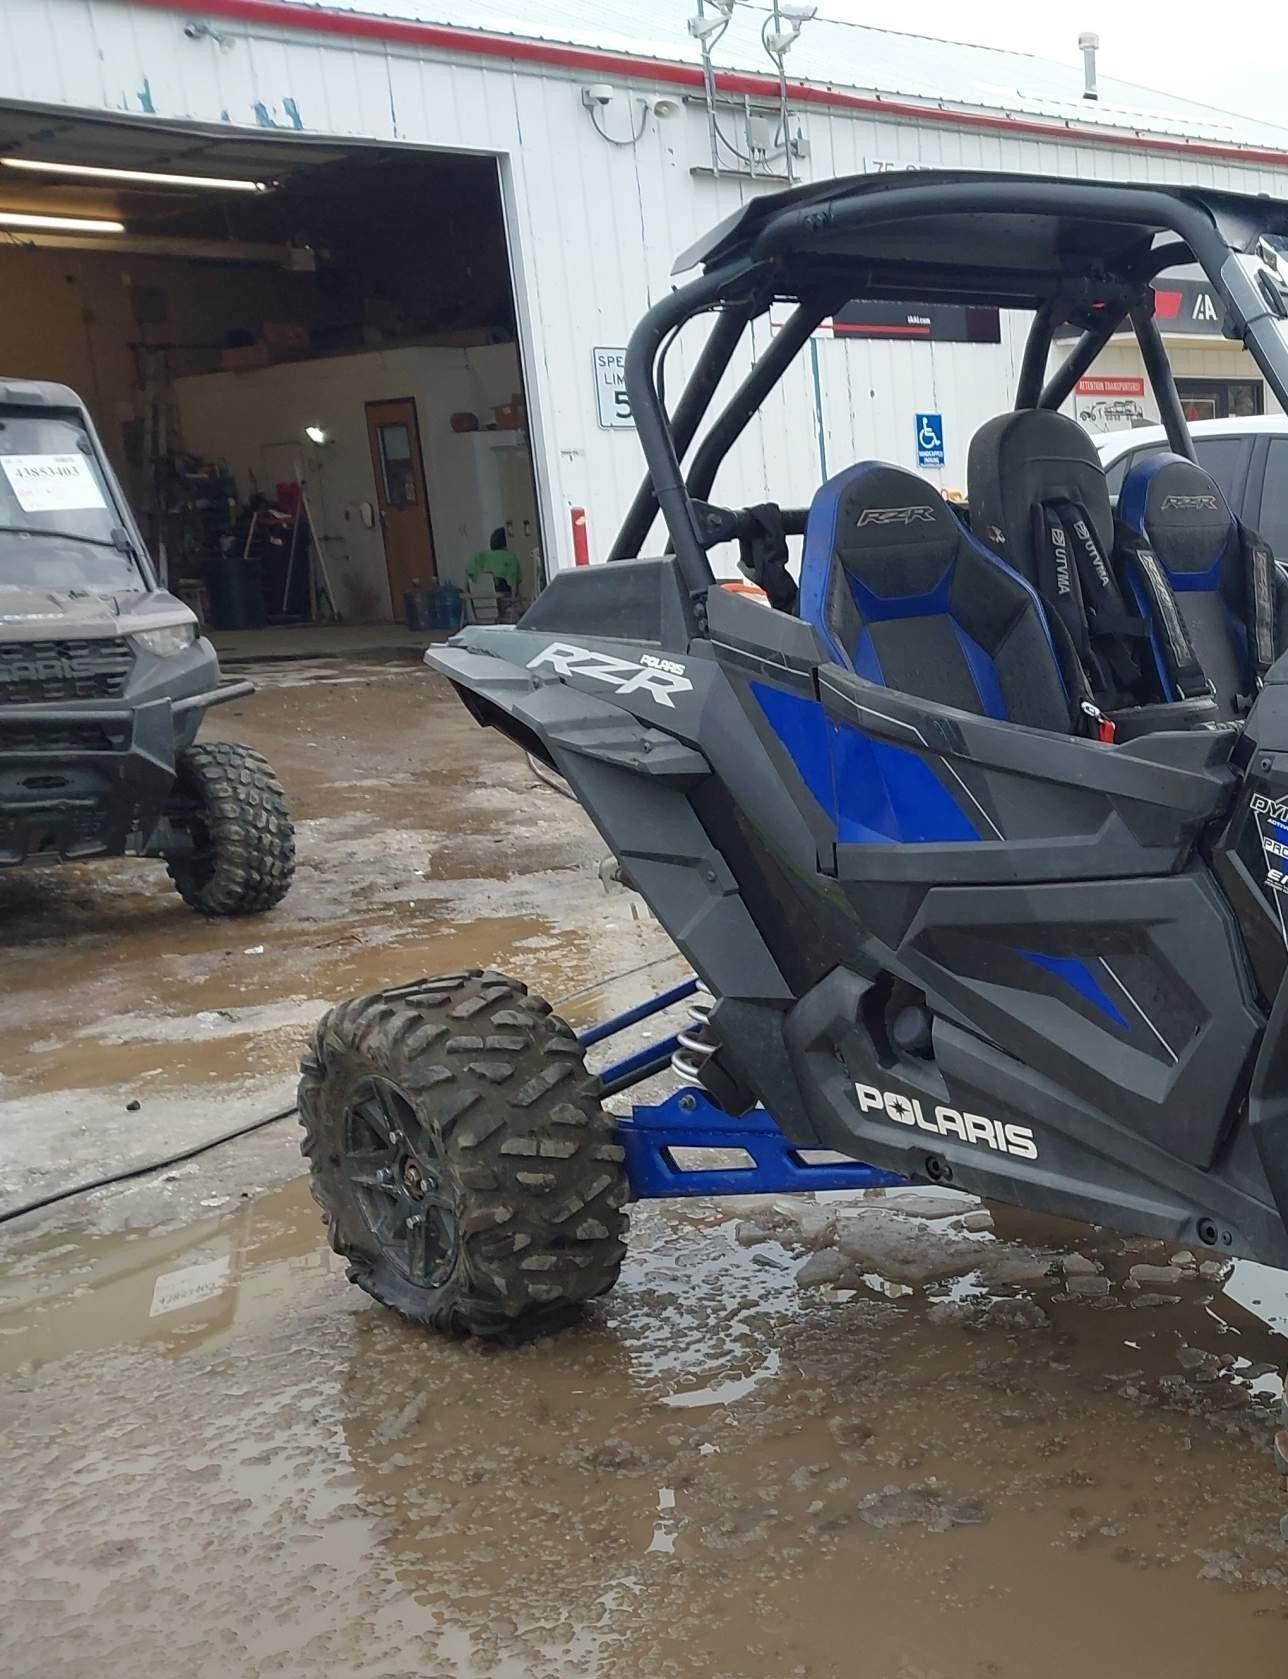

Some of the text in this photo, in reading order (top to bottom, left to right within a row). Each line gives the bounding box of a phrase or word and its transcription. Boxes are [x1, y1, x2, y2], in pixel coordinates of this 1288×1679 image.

[598, 355, 625, 368] SPE
[604, 373, 625, 385] LIM
[614, 390, 632, 418] 5
[1161, 495, 1218, 511] RZR
[857, 505, 937, 528] RZR
[1055, 548, 1070, 595] UTVMA
[1085, 540, 1110, 587] UTVMA
[526, 642, 694, 708] RZR
[639, 654, 685, 675] POLARIS
[854, 1082, 1039, 1160] POLARIS
